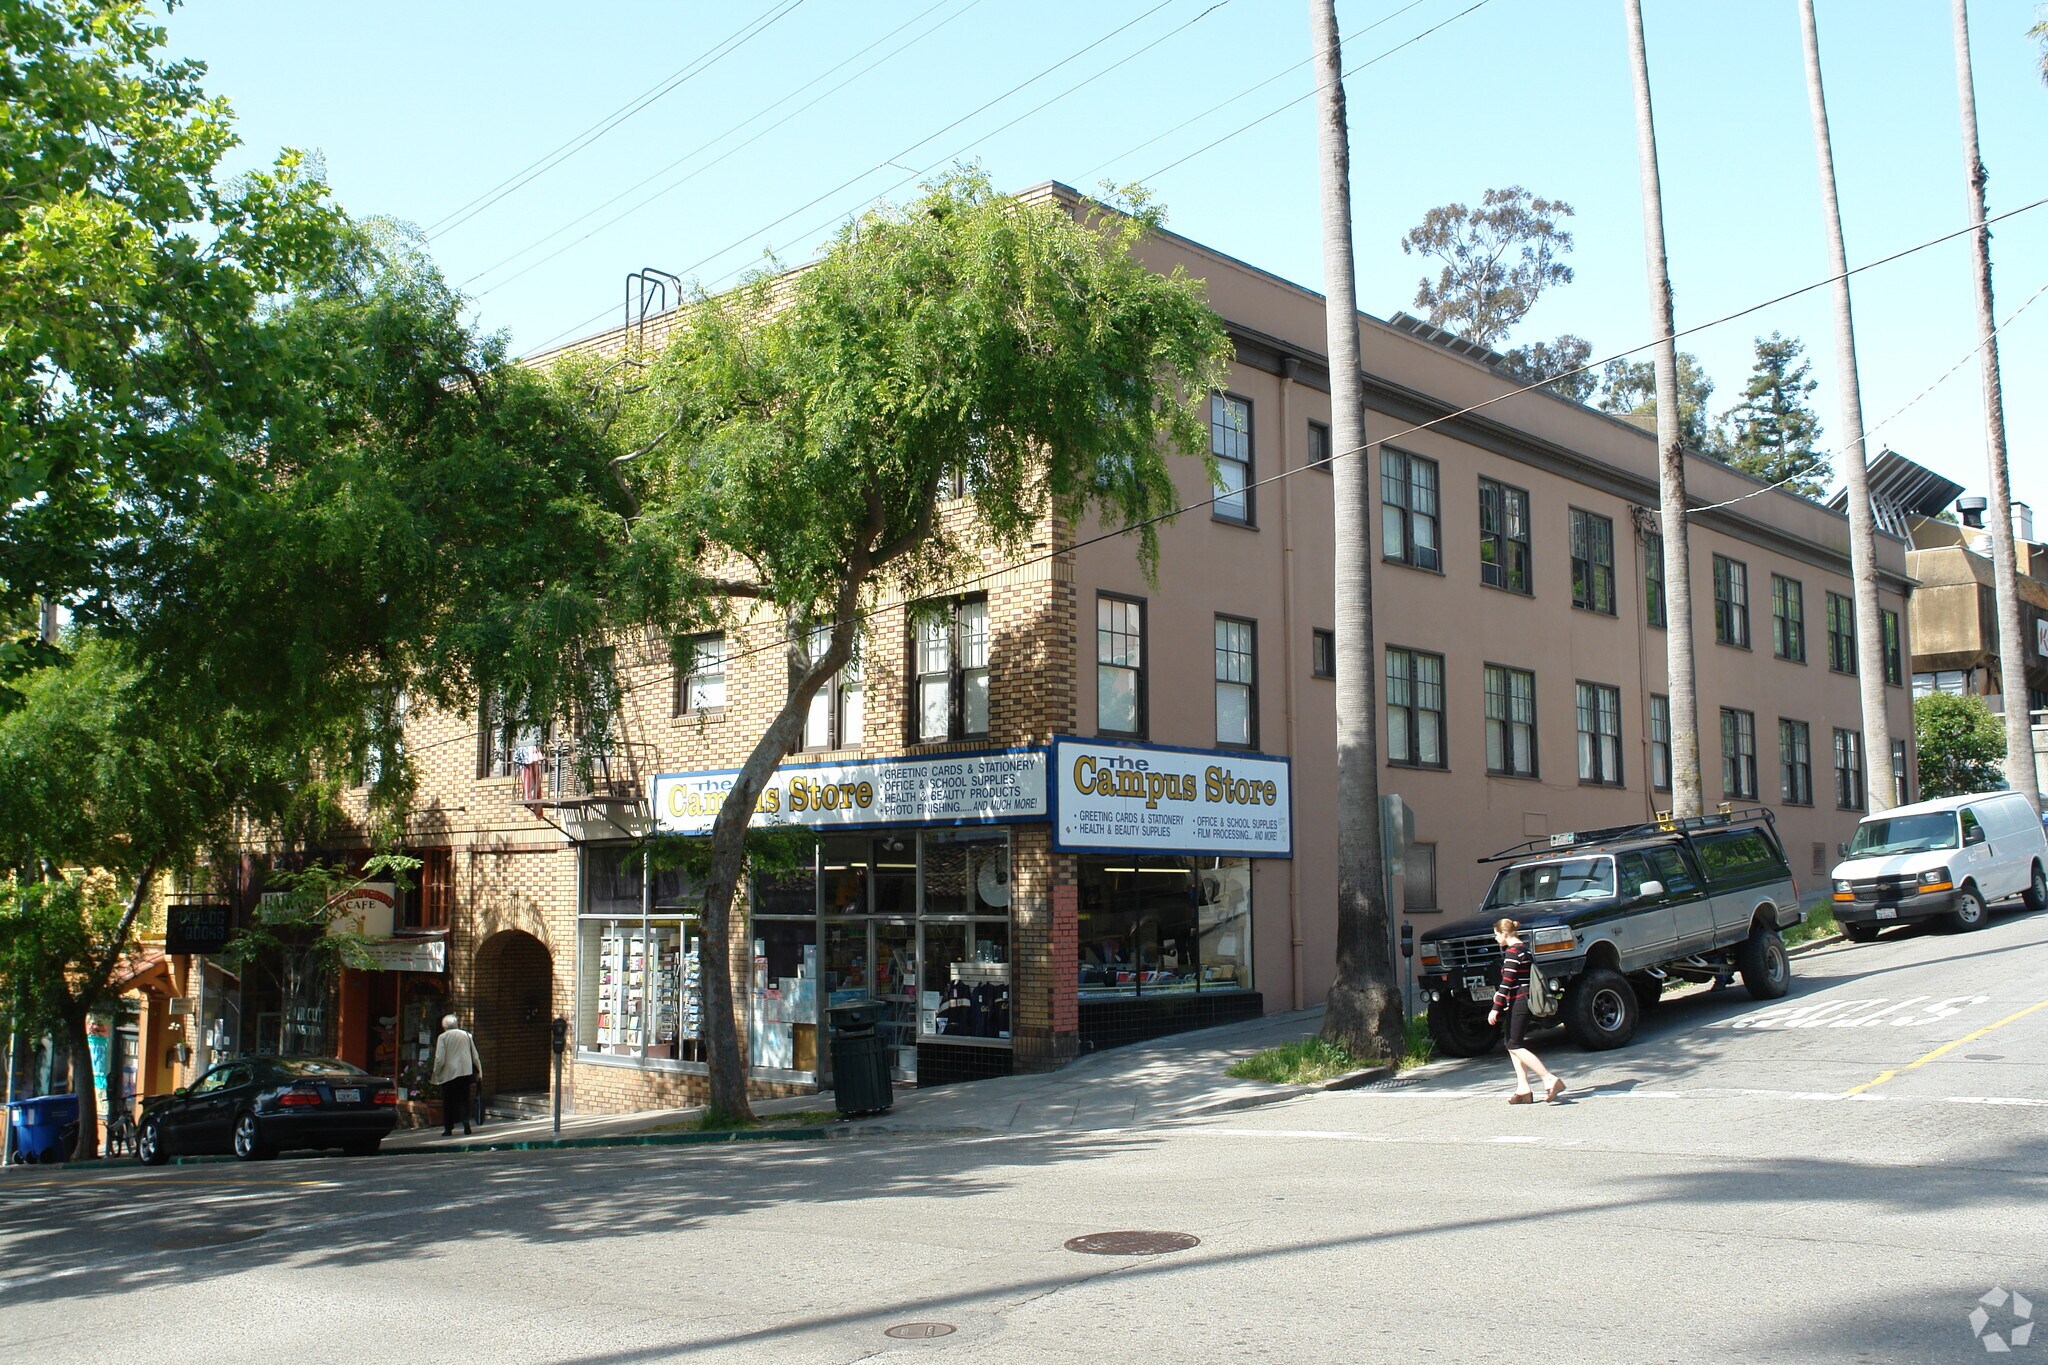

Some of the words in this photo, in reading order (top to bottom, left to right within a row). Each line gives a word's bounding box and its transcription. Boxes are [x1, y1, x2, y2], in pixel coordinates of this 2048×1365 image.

[885, 767, 927, 779] GREETING
[932, 765, 963, 776] CARDS
[967, 764, 974, 774] &
[978, 760, 1035, 773] STATIONERY
[1100, 755, 1149, 771] The
[690, 779, 733, 791] The
[885, 780, 914, 791] OFFICE
[919, 780, 925, 790] &
[930, 777, 967, 789] SCHOOL
[971, 773, 1015, 787] SUPPLIES
[1073, 755, 1197, 809] Campus
[1205, 765, 1277, 806] Store
[789, 776, 873, 811] Store
[885, 792, 916, 803] HEALTH
[920, 791, 926, 802] &
[931, 789, 966, 801] BEAUTY
[970, 786, 1021, 799] PRODUCTS
[885, 804, 913, 816] PHOTO
[973, 800, 988, 811] AND
[991, 799, 1011, 810] MUCH
[1014, 798, 1038, 809] MORE!
[1080, 810, 1113, 822] GREETING
[1116, 812, 1138, 823] CARDS
[1140, 813, 1145, 823] &
[1148, 814, 1184, 826] STATIONERY
[1197, 816, 1218, 827] OFFICE
[1220, 817, 1225, 827] &
[1226, 818, 1250, 829] SCHOOL
[1252, 819, 1278, 830] SUPPLIES
[1080, 823, 1105, 835] HEALTH
[1108, 824, 1112, 835] &
[1115, 824, 1140, 836] BEAUTY
[1142, 826, 1171, 838] SUPPLIES
[1197, 828, 1211, 839] FILM
[1254, 830, 1263, 840] AND
[1265, 831, 1277, 841] MORE!
[346, 900, 376, 910] CAFE
